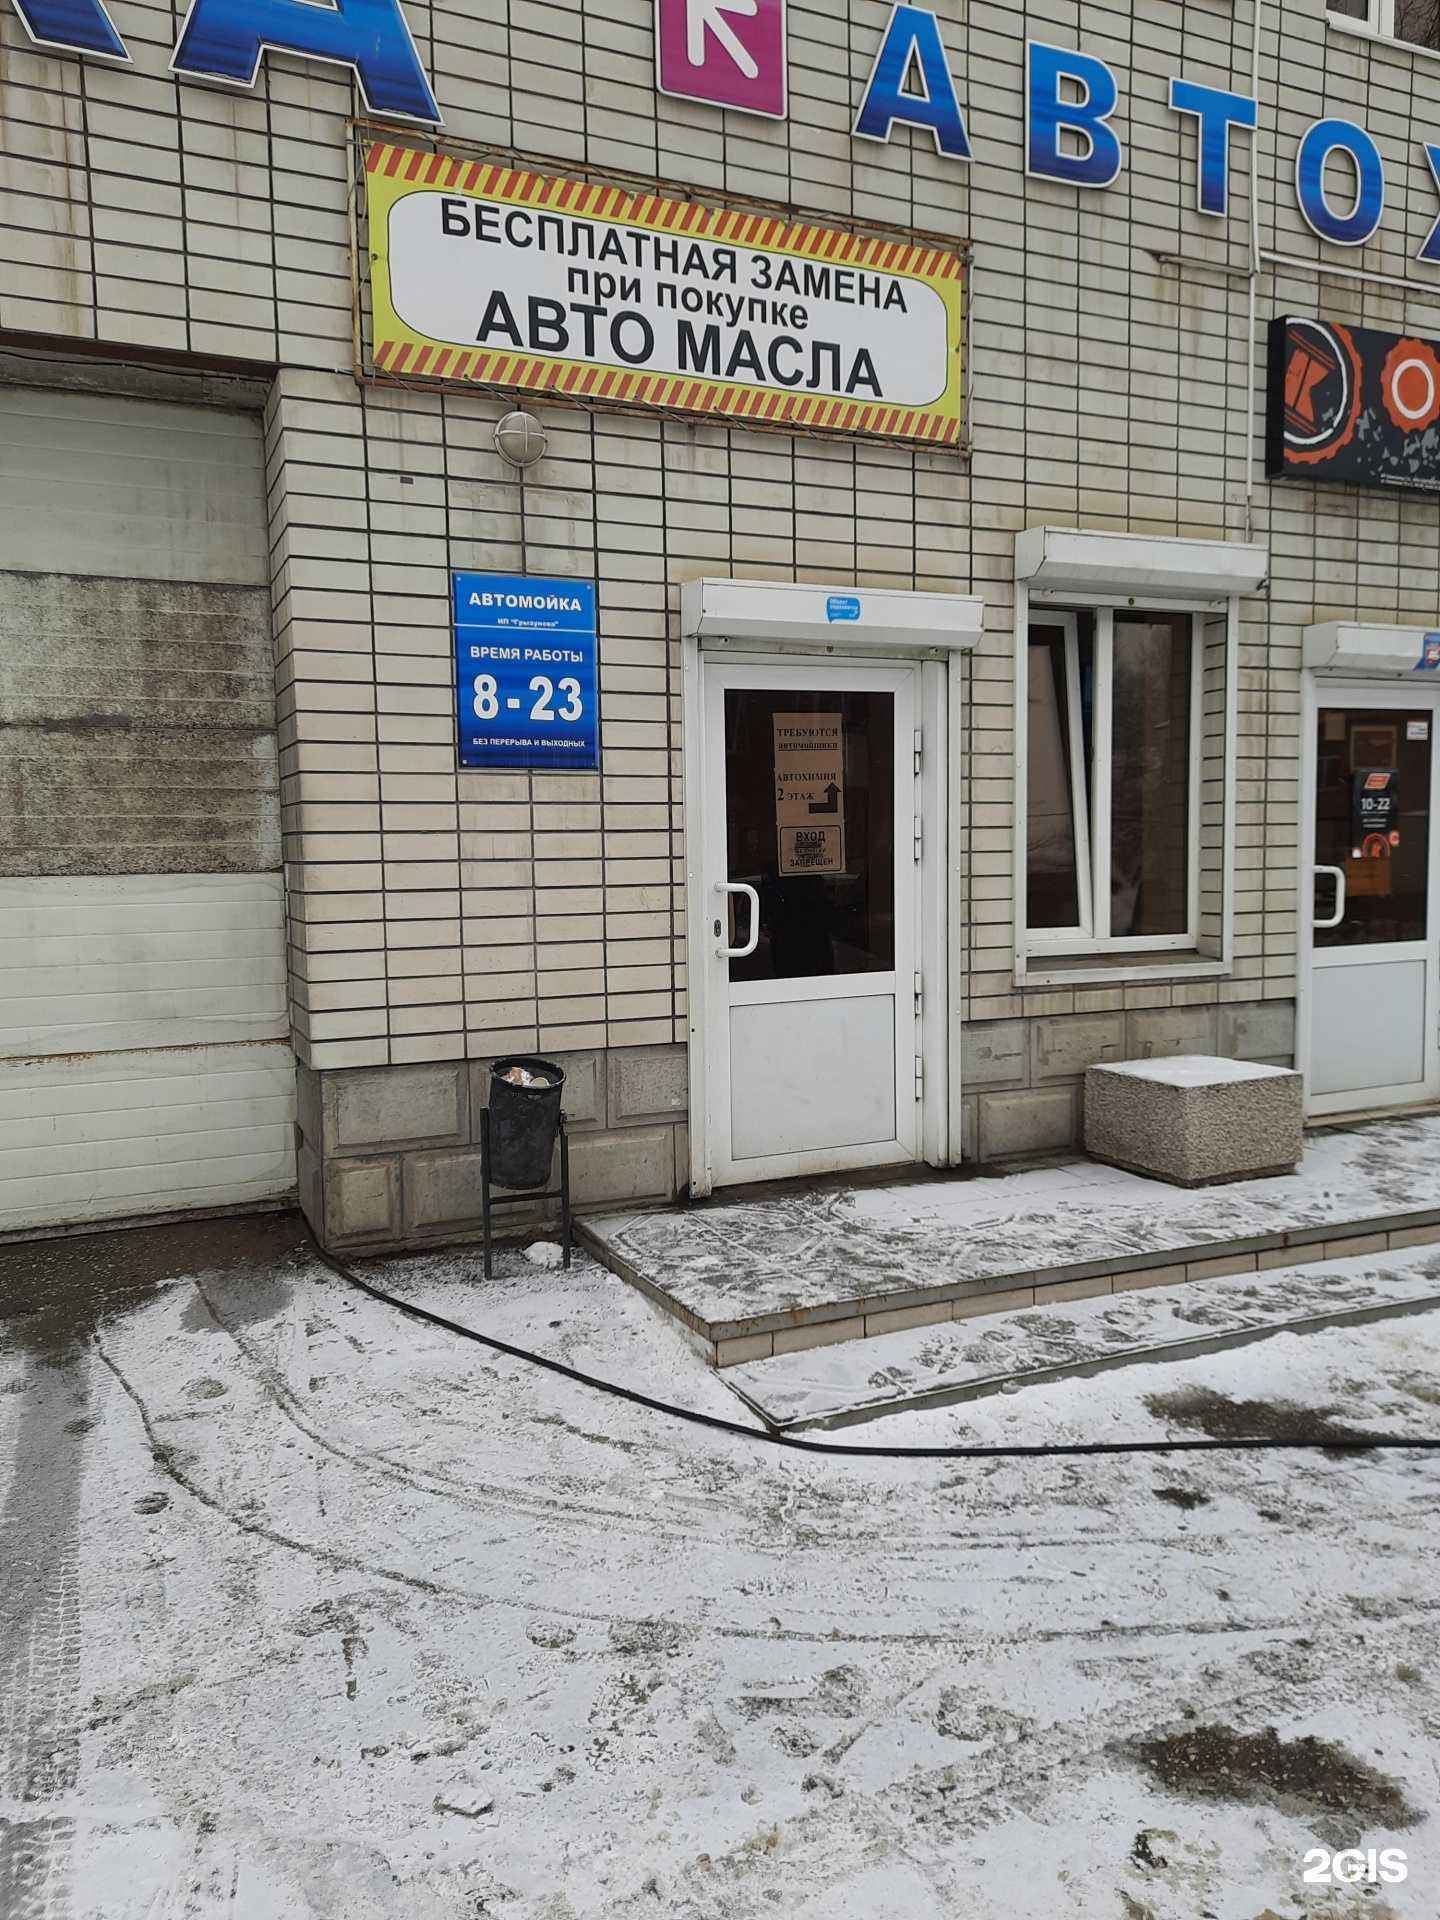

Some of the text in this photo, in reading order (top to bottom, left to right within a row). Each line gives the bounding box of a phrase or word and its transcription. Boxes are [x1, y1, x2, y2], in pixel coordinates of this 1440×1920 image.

[850, 0, 1440, 264] АВТО
[441, 197, 908, 314] БЕСПЛАТНАЯ ЗАМЕНА
[567, 266, 809, 330] при покупке
[475, 290, 884, 398] АВТО МАСЛА
[469, 592, 582, 612] АВТОМОЙКА
[470, 646, 583, 662] ВРЕМЯ РАБОТЫ
[776, 727, 838, 737] ТРЕБУЮТСЯ
[489, 738, 533, 746] ПЕРЕРЫВА
[541, 739, 585, 748] ВЫХОДНЫХ
[776, 772, 836, 782] АВТОХИМИЯ
[777, 788, 816, 801] 2 ЭТАЖ
[1361, 798, 1391, 811] 10-22
[796, 831, 826, 843] ВХОД
